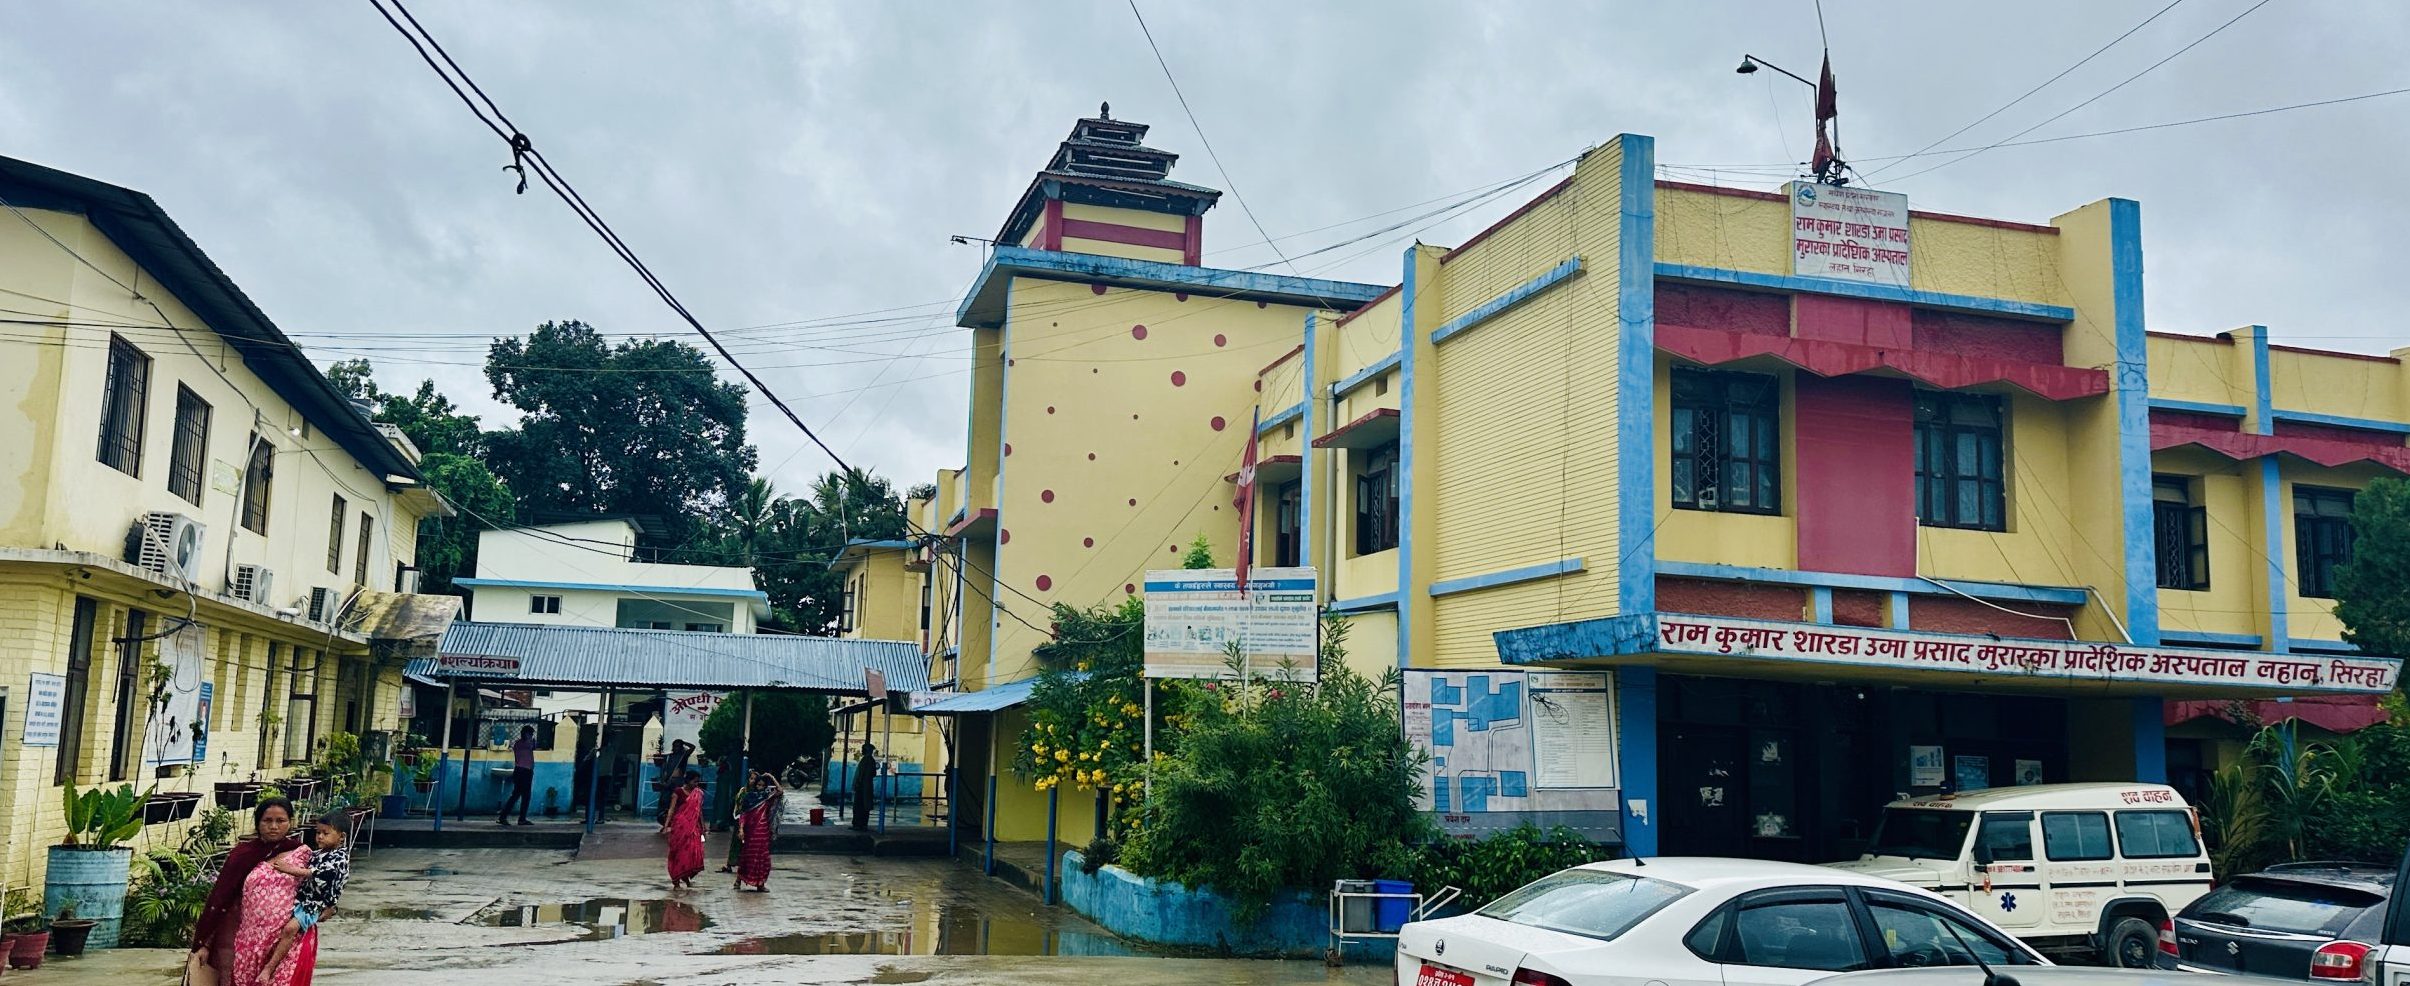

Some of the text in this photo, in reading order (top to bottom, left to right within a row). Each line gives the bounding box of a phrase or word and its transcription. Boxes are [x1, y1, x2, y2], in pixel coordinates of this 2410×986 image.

[1796, 217, 1815, 232] राम
[1816, 219, 1843, 239] कुमार
[1796, 239, 1908, 266] मुरारका प्रादेशिक अस्पताल
[447, 655, 512, 670] शल्यक्रिया
[1660, 621, 1712, 645] राम
[1715, 626, 1788, 653] कुमार
[1865, 637, 1910, 659] उमा
[1913, 640, 1974, 664] प्रसाद
[1977, 644, 2060, 670] मुरारका
[2064, 645, 2148, 674] प्रादेशिक
[2149, 652, 2250, 677] अस्पताल
[2331, 660, 2388, 688] सिरहा
[2122, 789, 2172, 805] शव वाहन
[1486, 964, 1509, 975] RAPID
